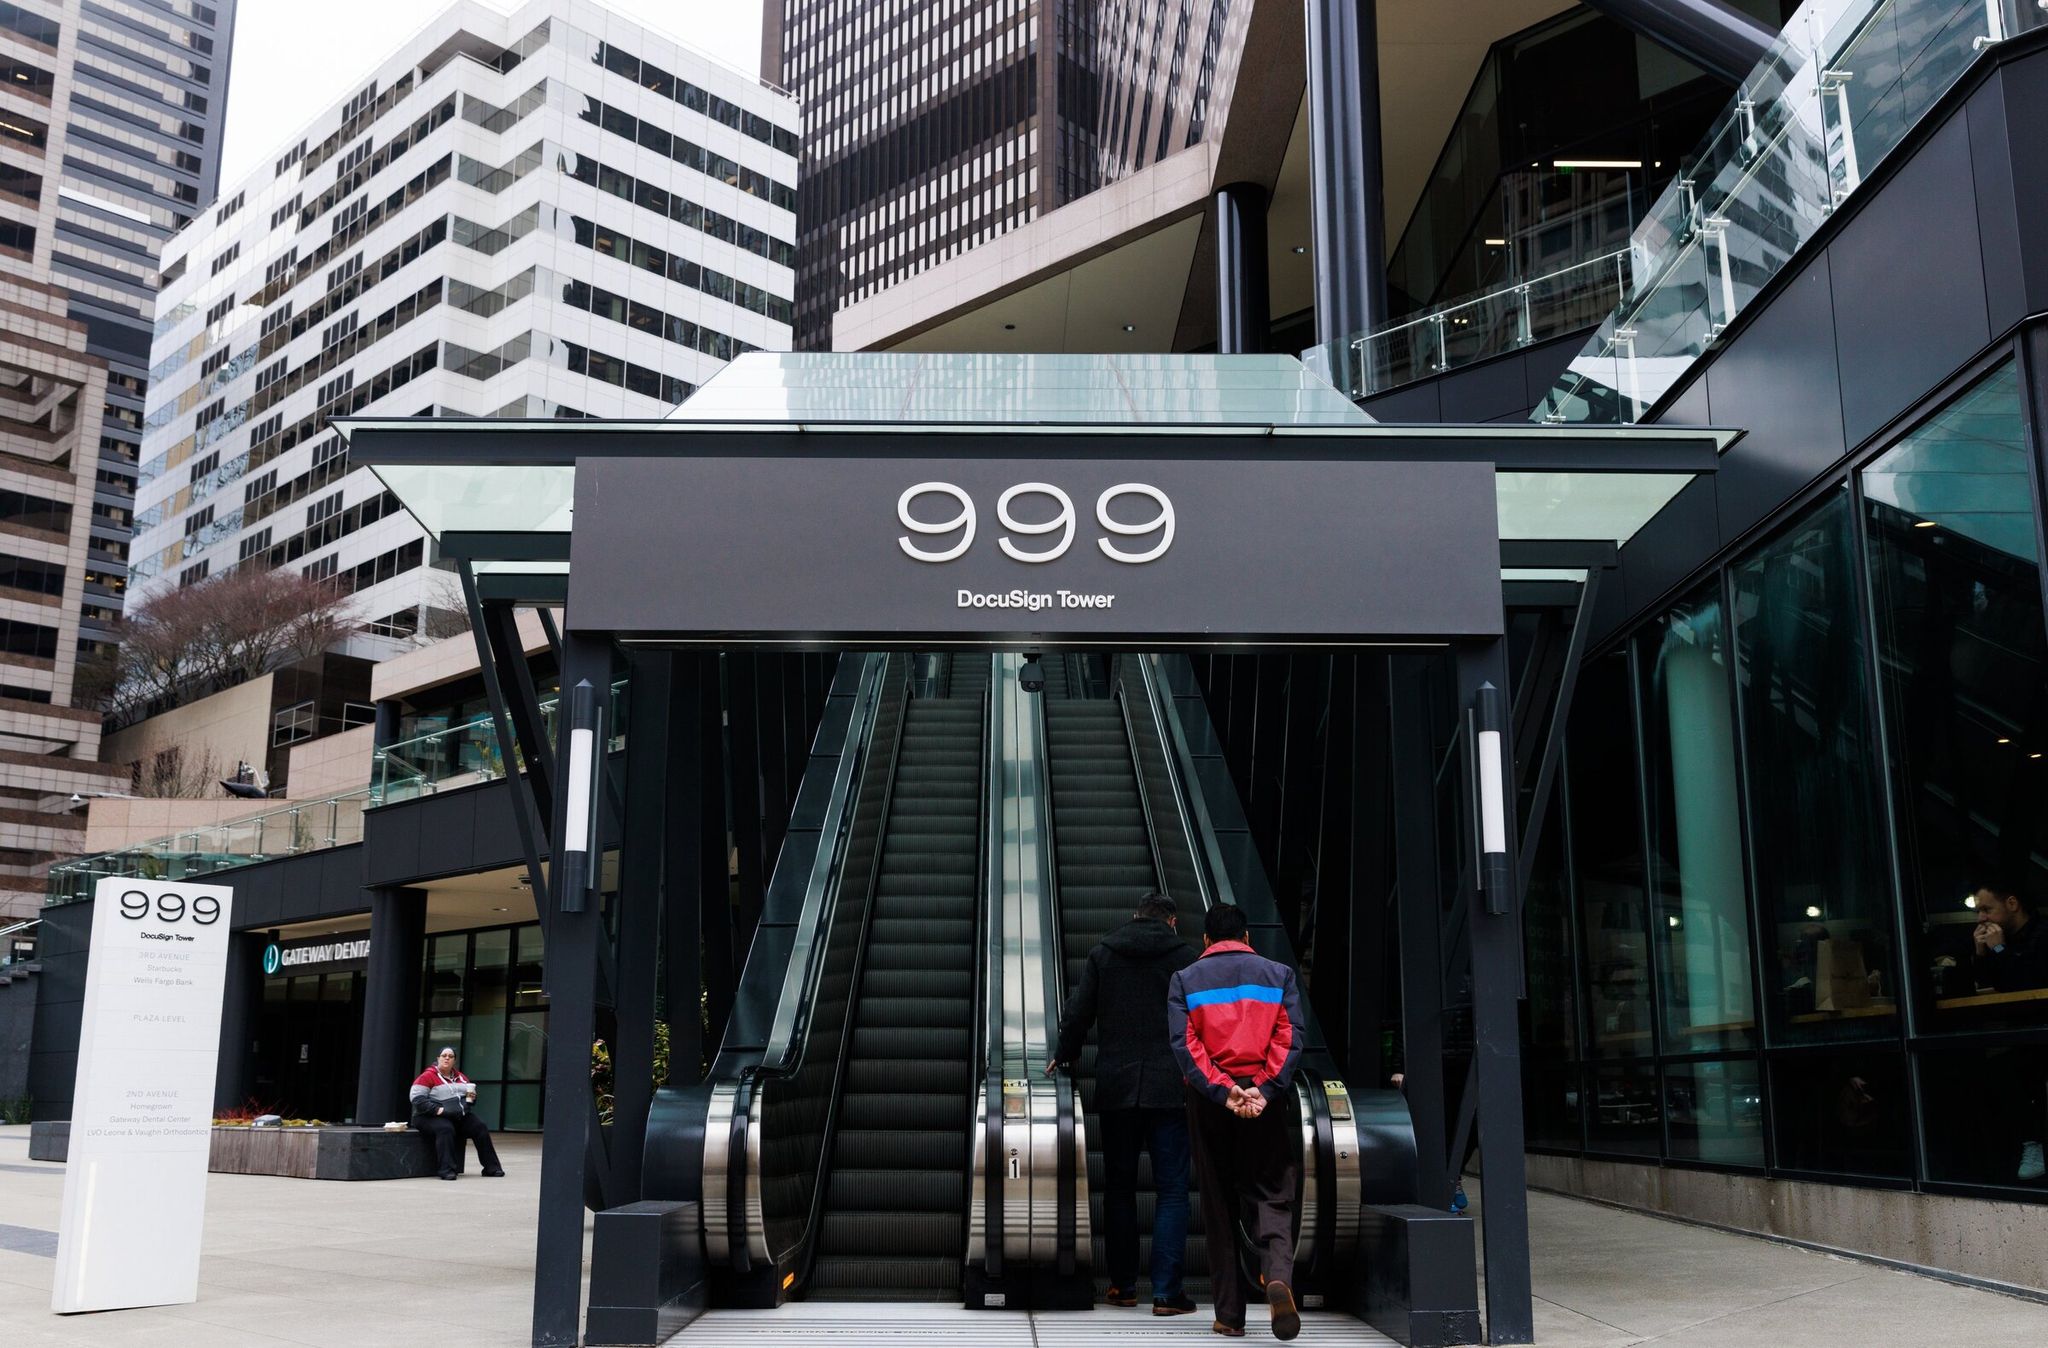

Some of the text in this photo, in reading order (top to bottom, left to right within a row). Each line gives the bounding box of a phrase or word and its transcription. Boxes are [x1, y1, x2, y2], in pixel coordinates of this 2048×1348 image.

[897, 481, 1176, 564] 999
[957, 589, 1115, 612] DocuSign Tower
[120, 890, 221, 925] 999
[140, 931, 195, 942] DocuSign Tower
[138, 951, 191, 961] 3RD AVENUE
[281, 944, 334, 966] GATEWAY
[147, 964, 183, 973] Starbucks
[133, 976, 193, 987] Wells Fargo Bank
[133, 1014, 186, 1023] PLAZA LEVEL
[126, 1090, 179, 1098] 2ND AVENUE
[130, 1103, 173, 1111] Homegrown
[109, 1115, 191, 1124] Gateway Dental Center
[163, 1128, 209, 1136] Orthodontics
[1011, 1158, 1018, 1179] 1
